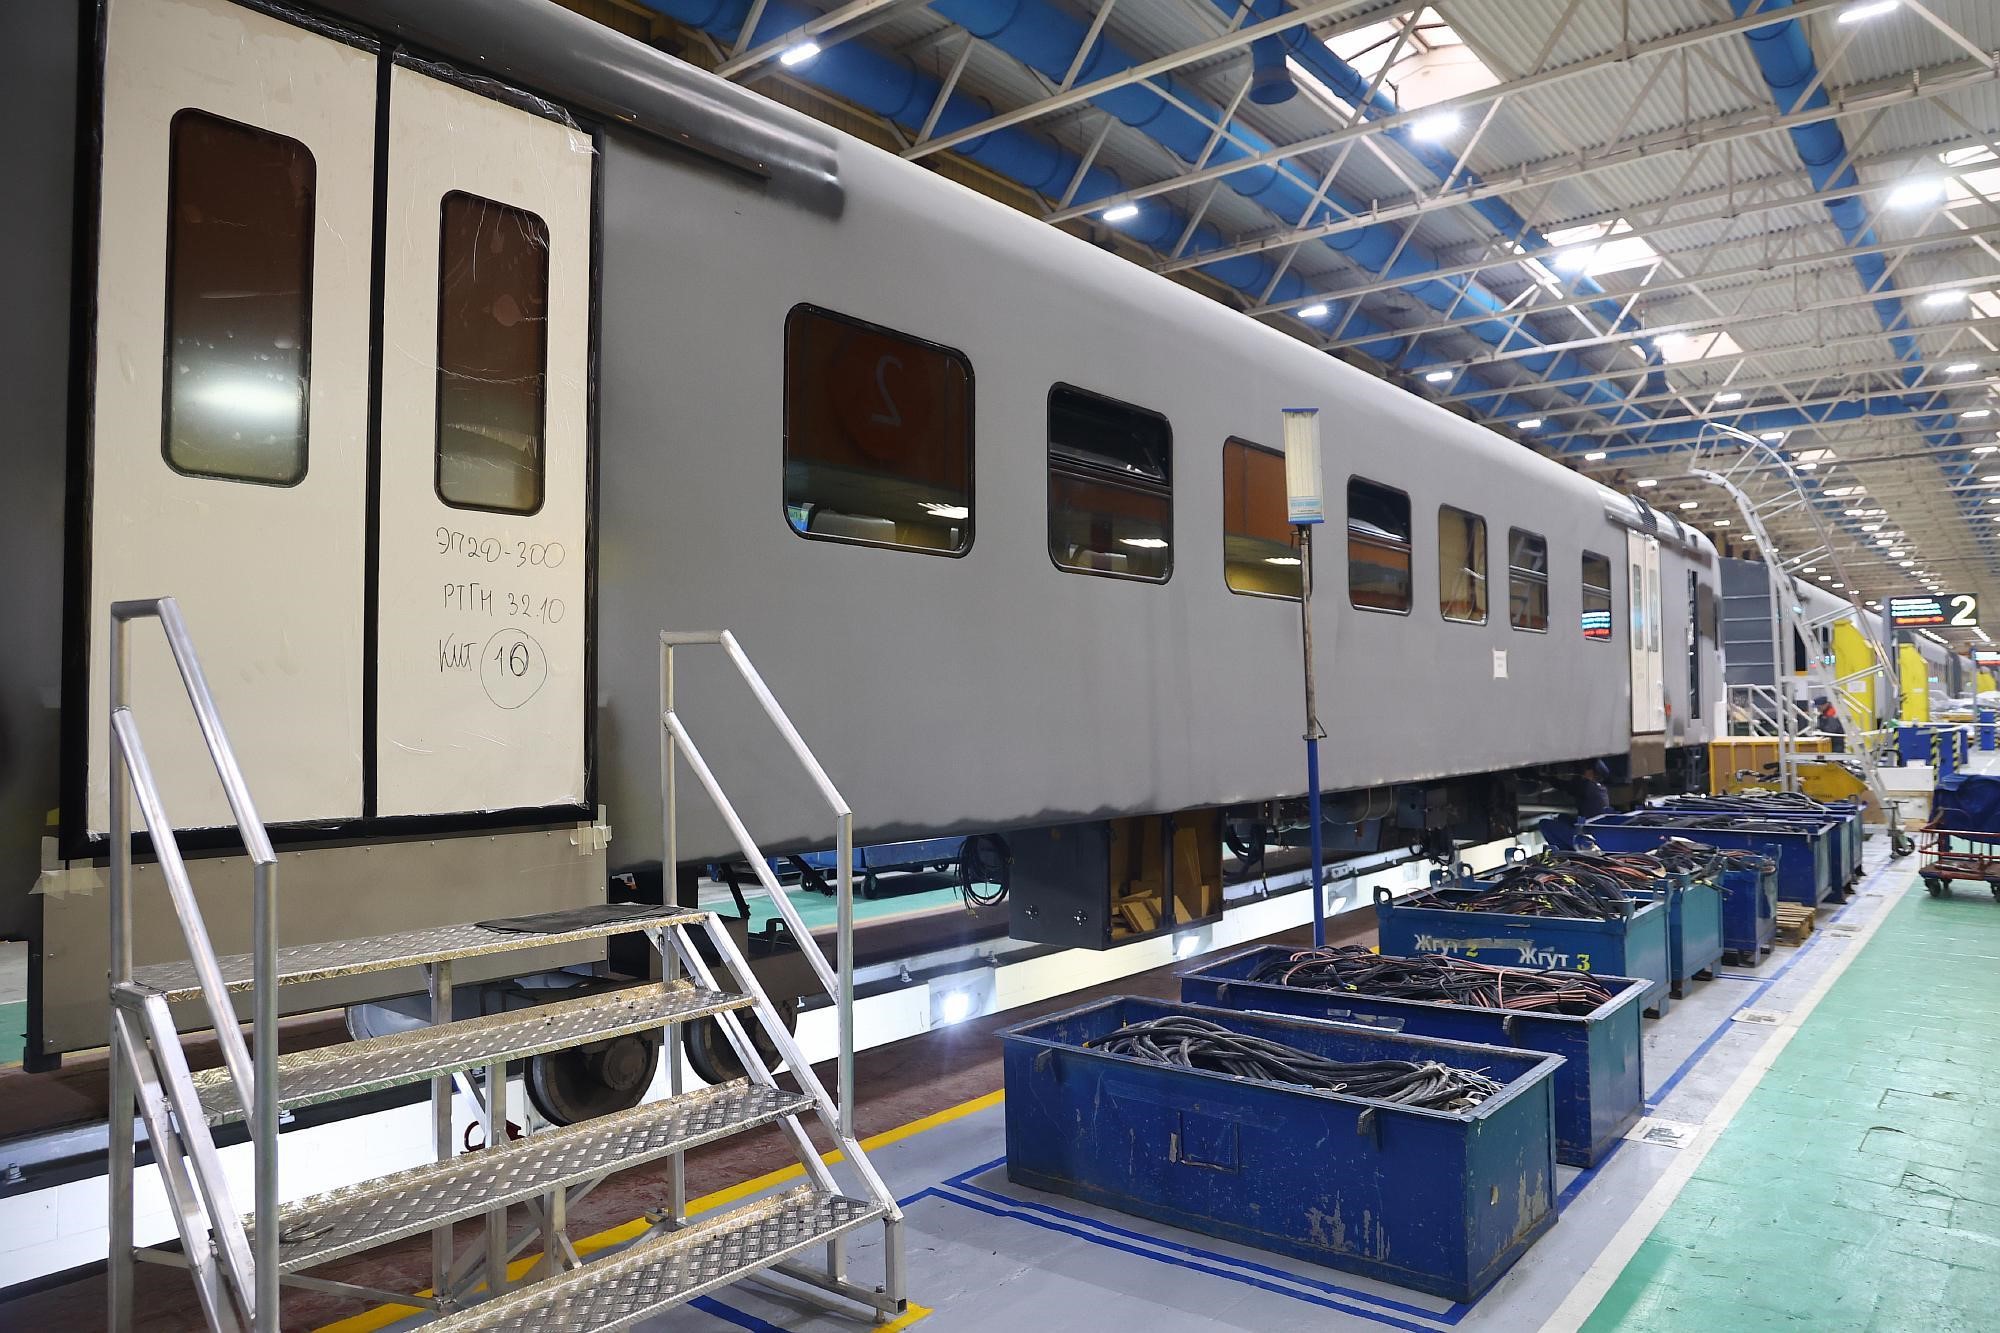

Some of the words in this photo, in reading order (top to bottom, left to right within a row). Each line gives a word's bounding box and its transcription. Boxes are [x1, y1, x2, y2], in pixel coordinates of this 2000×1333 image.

[508, 592, 565, 624] 32.10
[1950, 595, 1977, 626] 2
[1519, 947, 1570, 970] Жгут
[1576, 953, 1591, 971] 3
